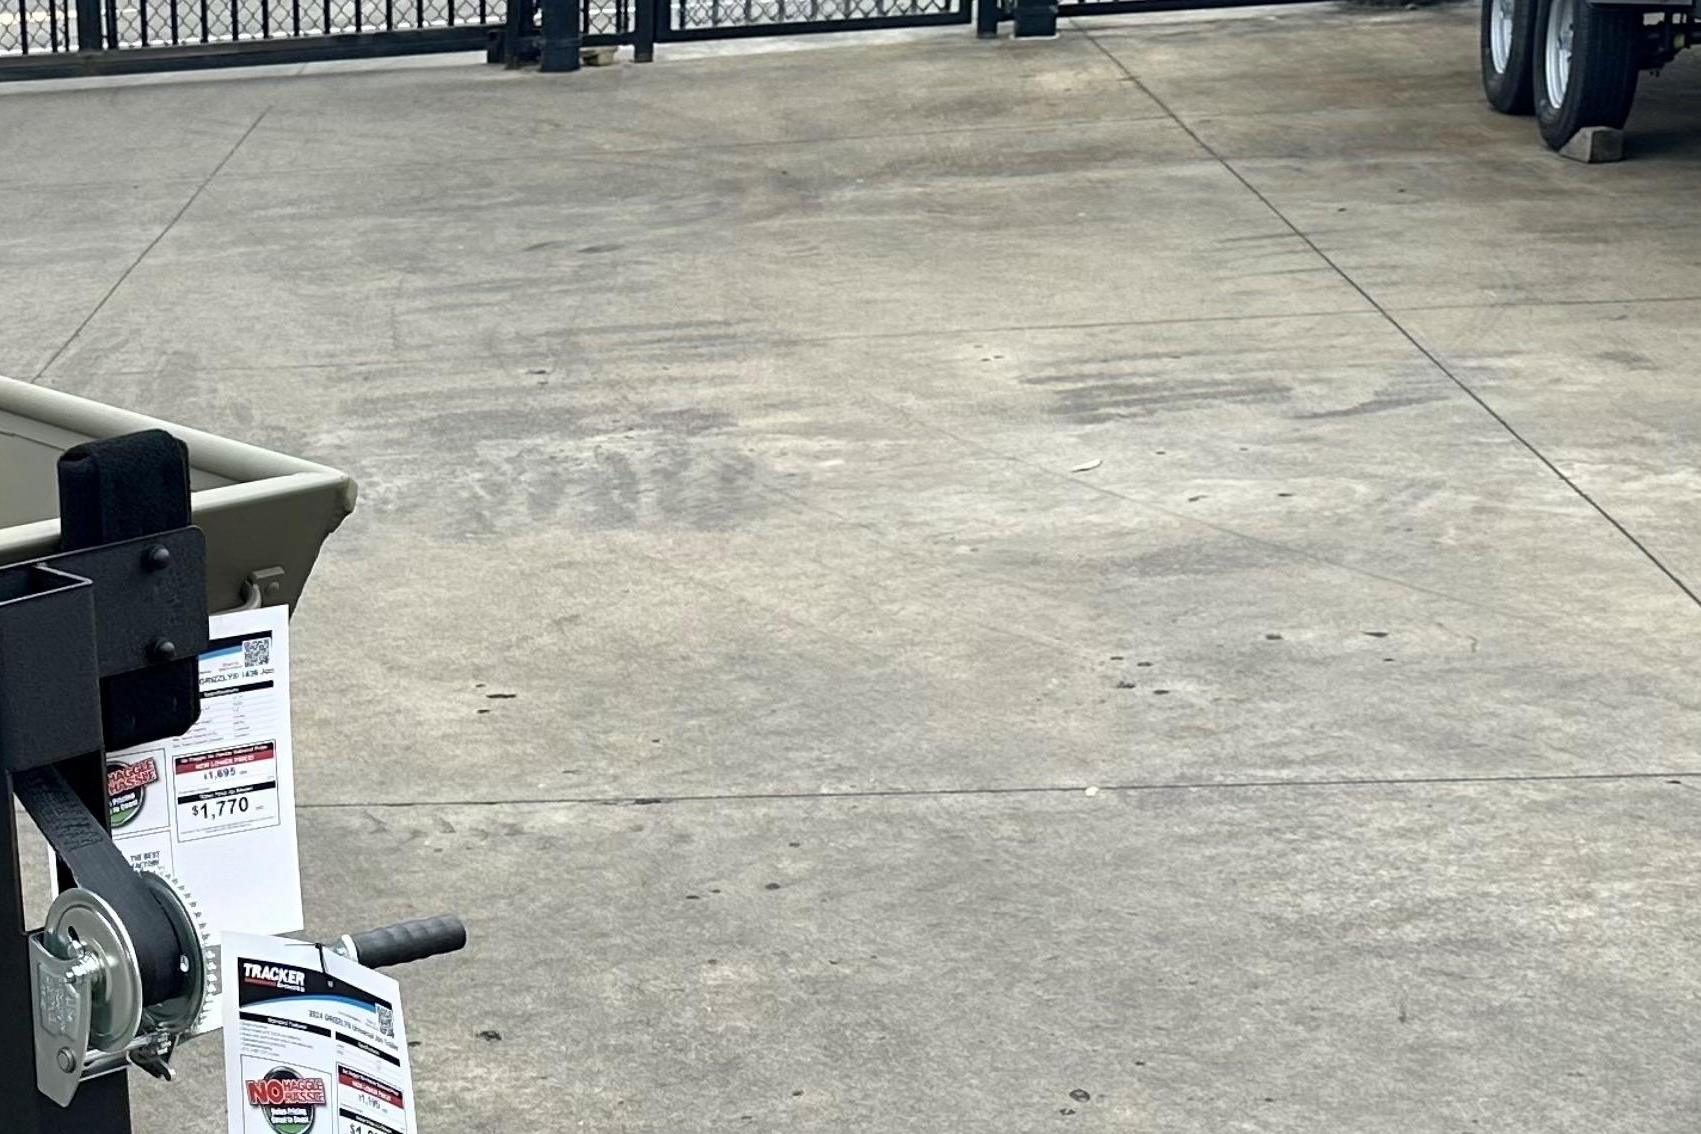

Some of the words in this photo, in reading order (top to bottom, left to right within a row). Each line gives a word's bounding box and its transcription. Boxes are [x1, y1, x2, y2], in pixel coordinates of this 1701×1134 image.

[192, 797, 249, 819] $1,770
[243, 962, 306, 986] TRACKER
[245, 1079, 284, 1105] NO
[282, 1078, 323, 1092] HAGGLE
